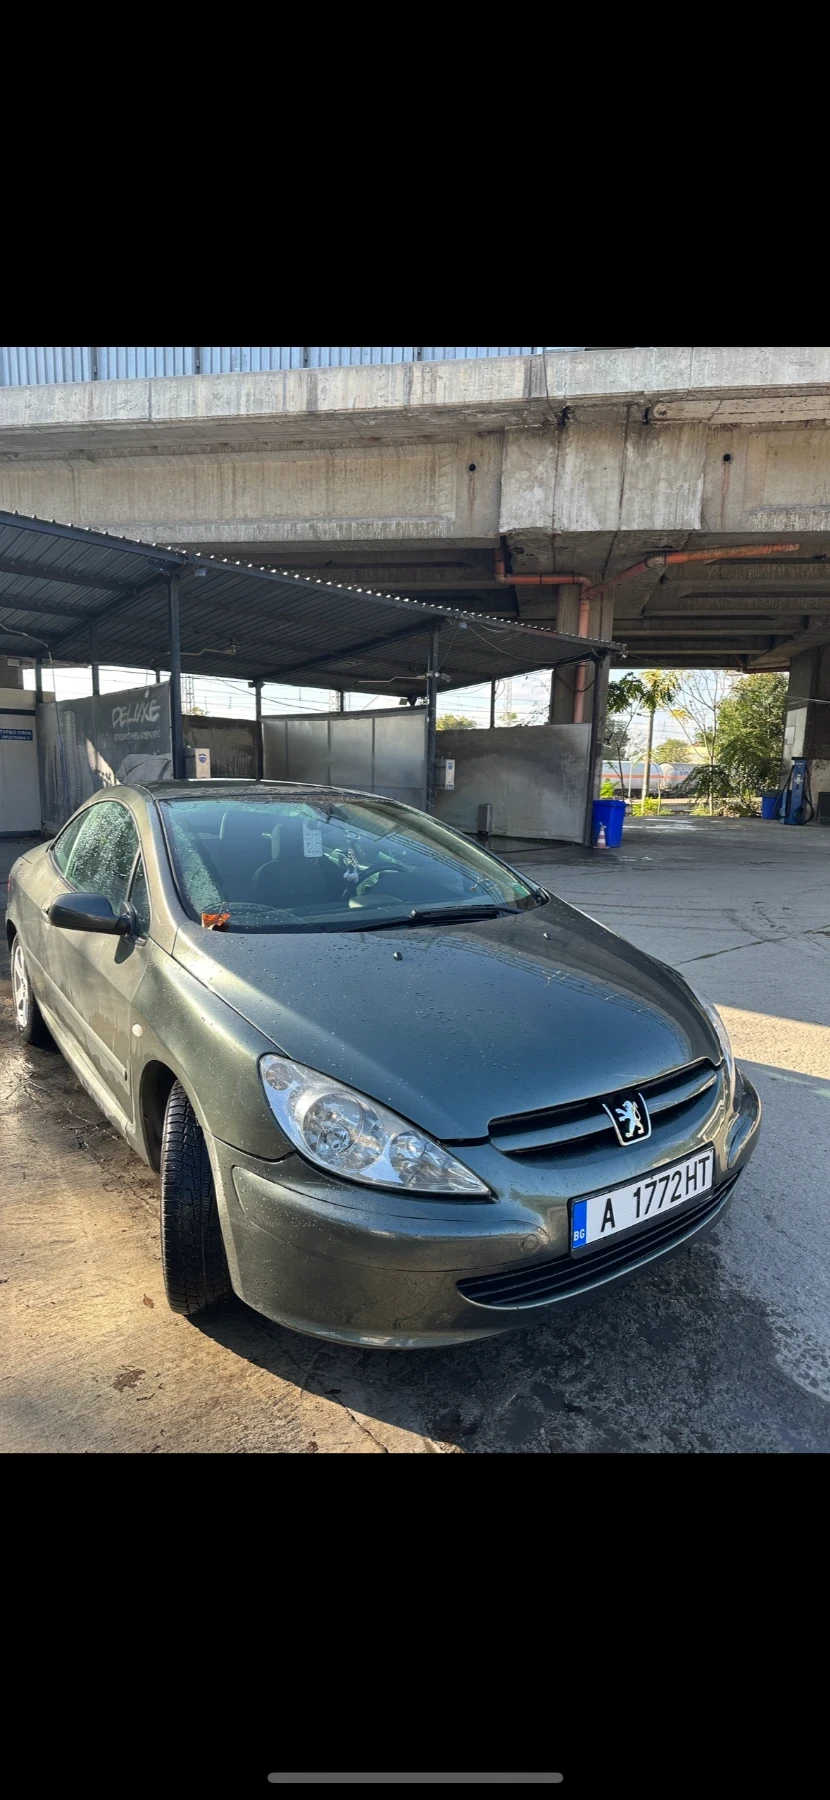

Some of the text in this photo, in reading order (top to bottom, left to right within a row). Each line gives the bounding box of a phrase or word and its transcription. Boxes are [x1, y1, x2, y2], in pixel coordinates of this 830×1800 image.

[112, 700, 160, 728] DELUXE
[600, 1198, 616, 1233] A
[573, 1228, 586, 1241] BG
